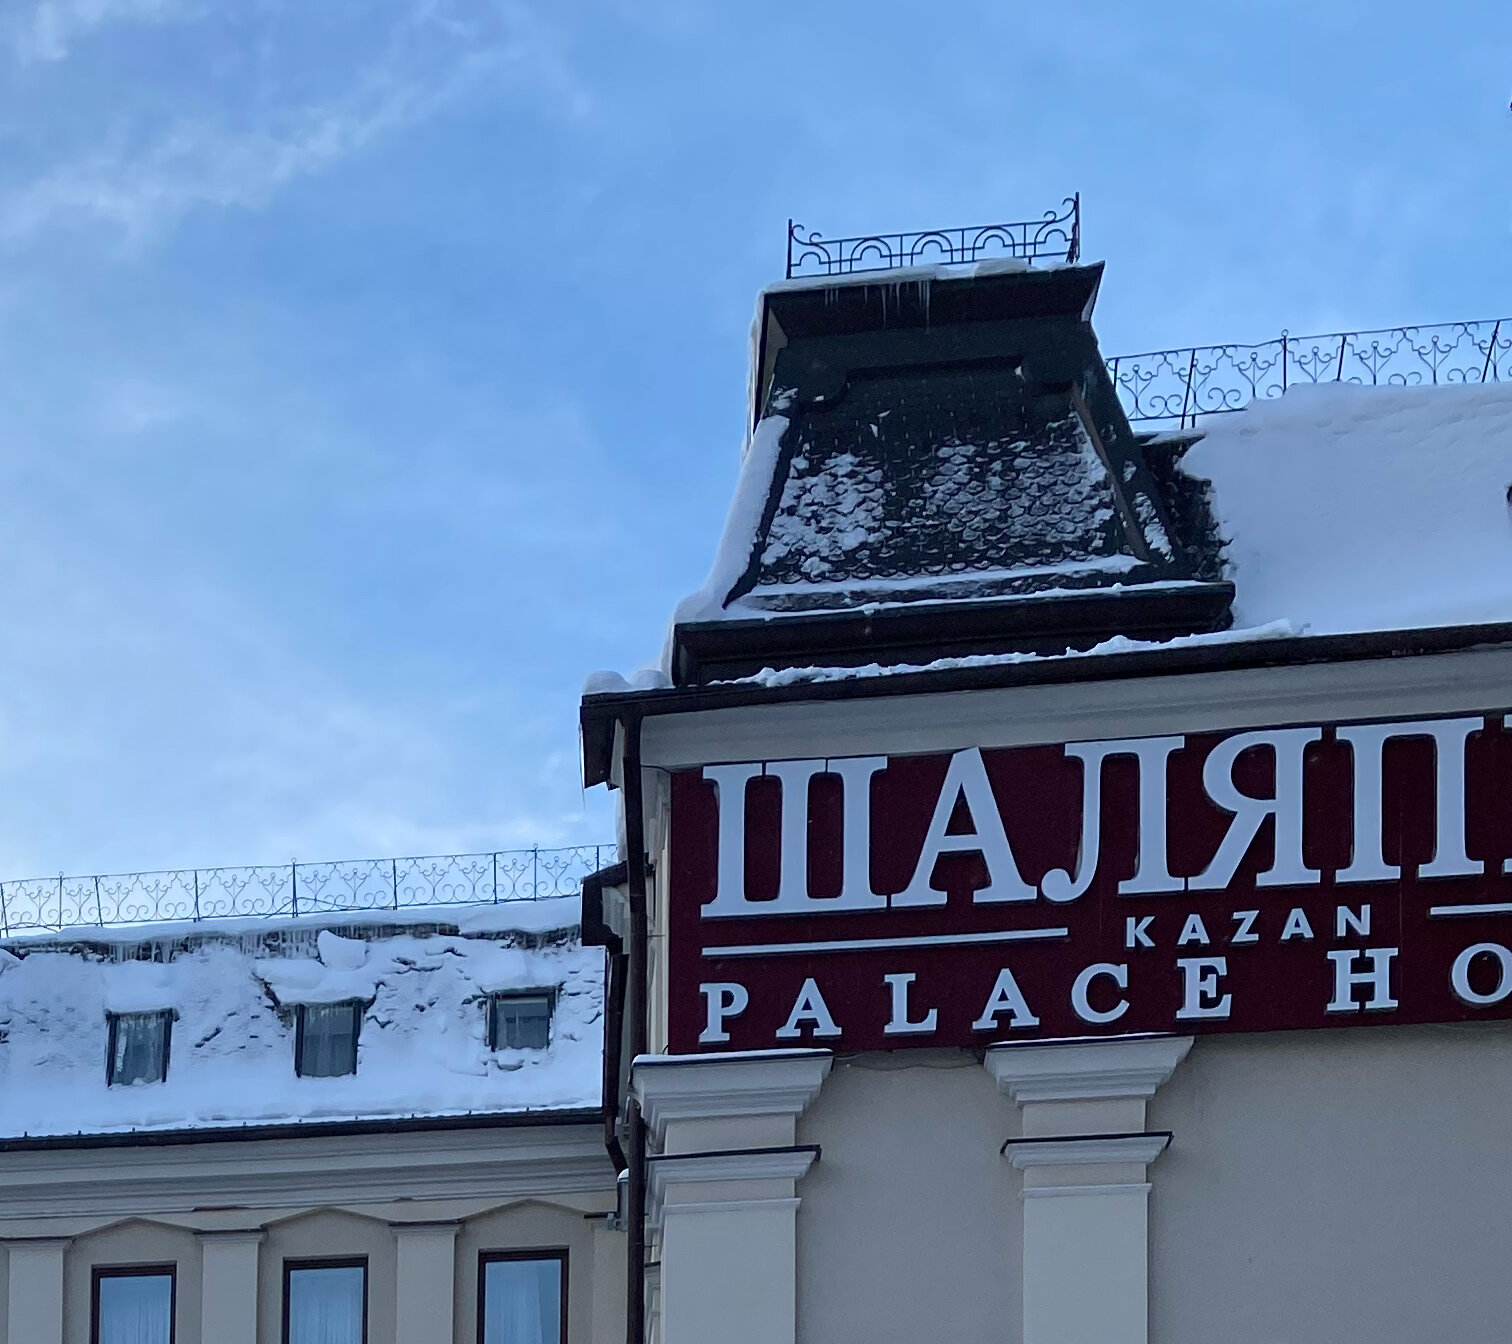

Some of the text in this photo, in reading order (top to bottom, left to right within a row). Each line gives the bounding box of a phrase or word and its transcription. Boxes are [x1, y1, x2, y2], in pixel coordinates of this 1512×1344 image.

[700, 714, 1511, 918] ШАЛЯП
[1126, 903, 1371, 948] KAZAN
[698, 957, 1232, 1042] PALACE
